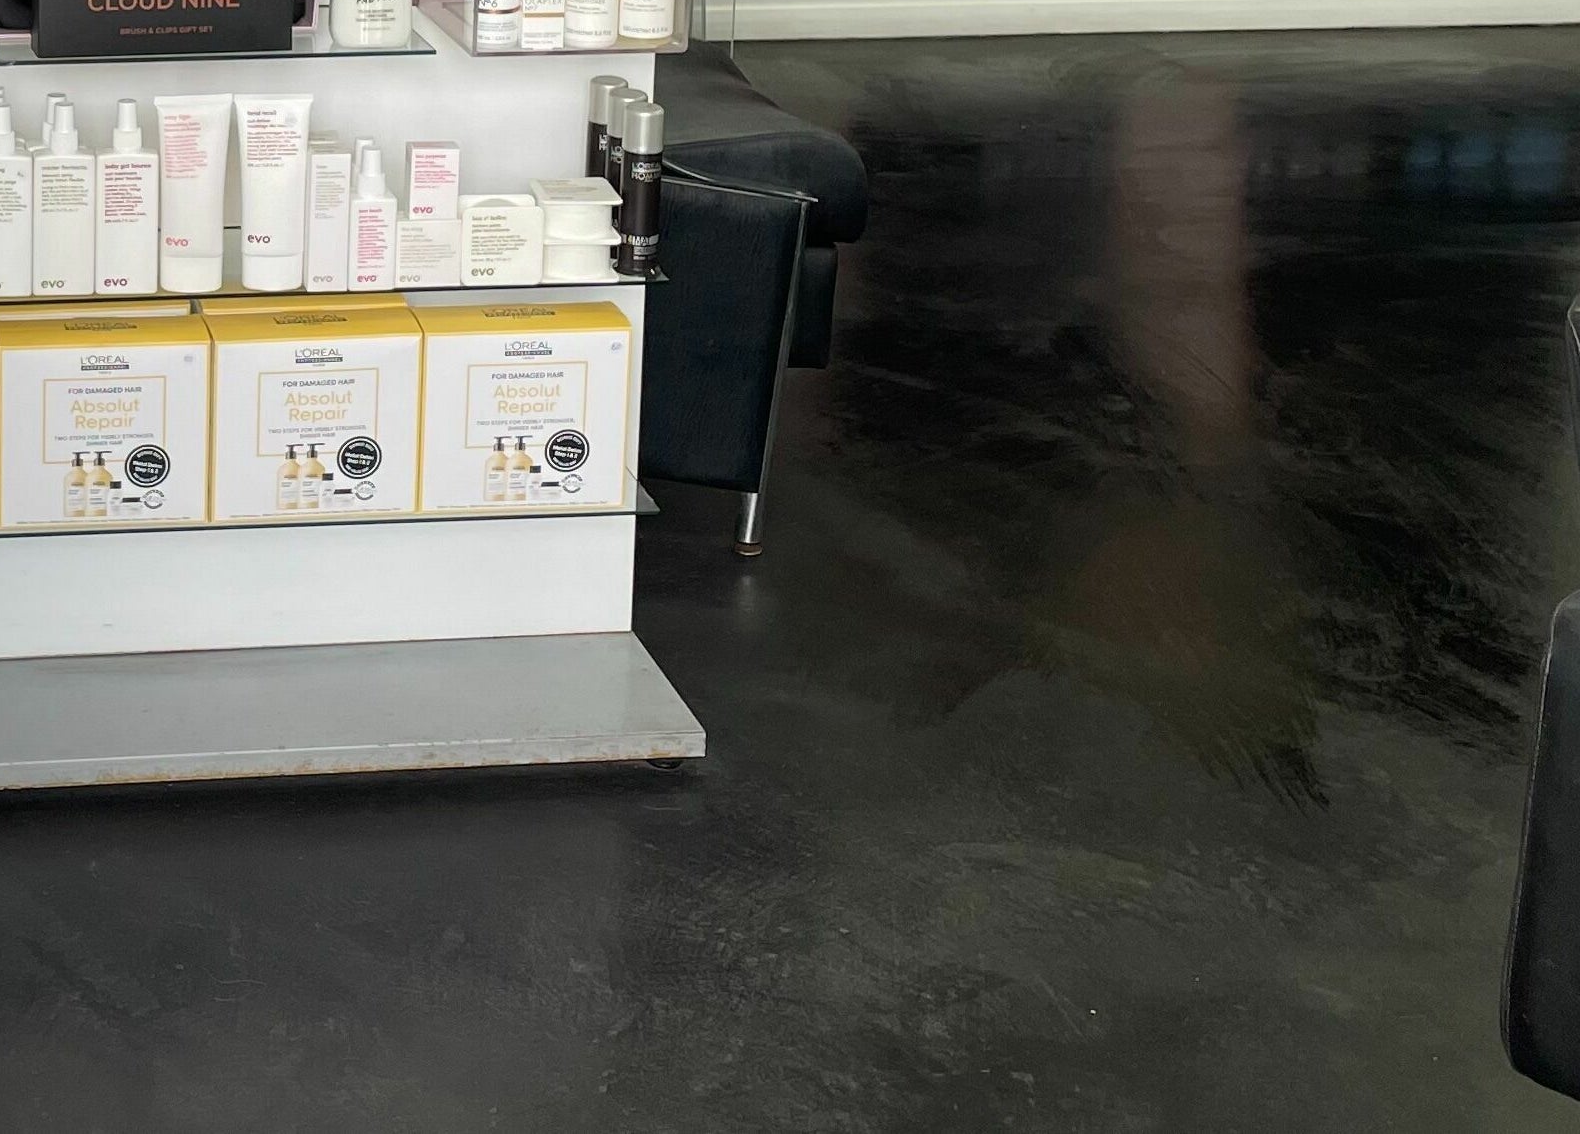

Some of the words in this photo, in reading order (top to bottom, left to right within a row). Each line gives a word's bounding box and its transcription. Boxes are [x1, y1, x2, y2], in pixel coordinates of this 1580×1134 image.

[413, 206, 433, 214] evo
[165, 237, 189, 247] evo
[247, 234, 271, 244] evo
[471, 268, 495, 276] evo
[104, 277, 128, 288] evo
[313, 275, 333, 283] evo
[357, 274, 377, 283] evo
[399, 274, 420, 282] evo
[41, 279, 64, 289] evo
[493, 384, 561, 399] Absolut
[284, 391, 352, 406] Absolut
[71, 399, 141, 414] Absolut
[497, 400, 557, 415] Repair
[289, 408, 347, 423] Repair
[75, 415, 136, 431] Repair
